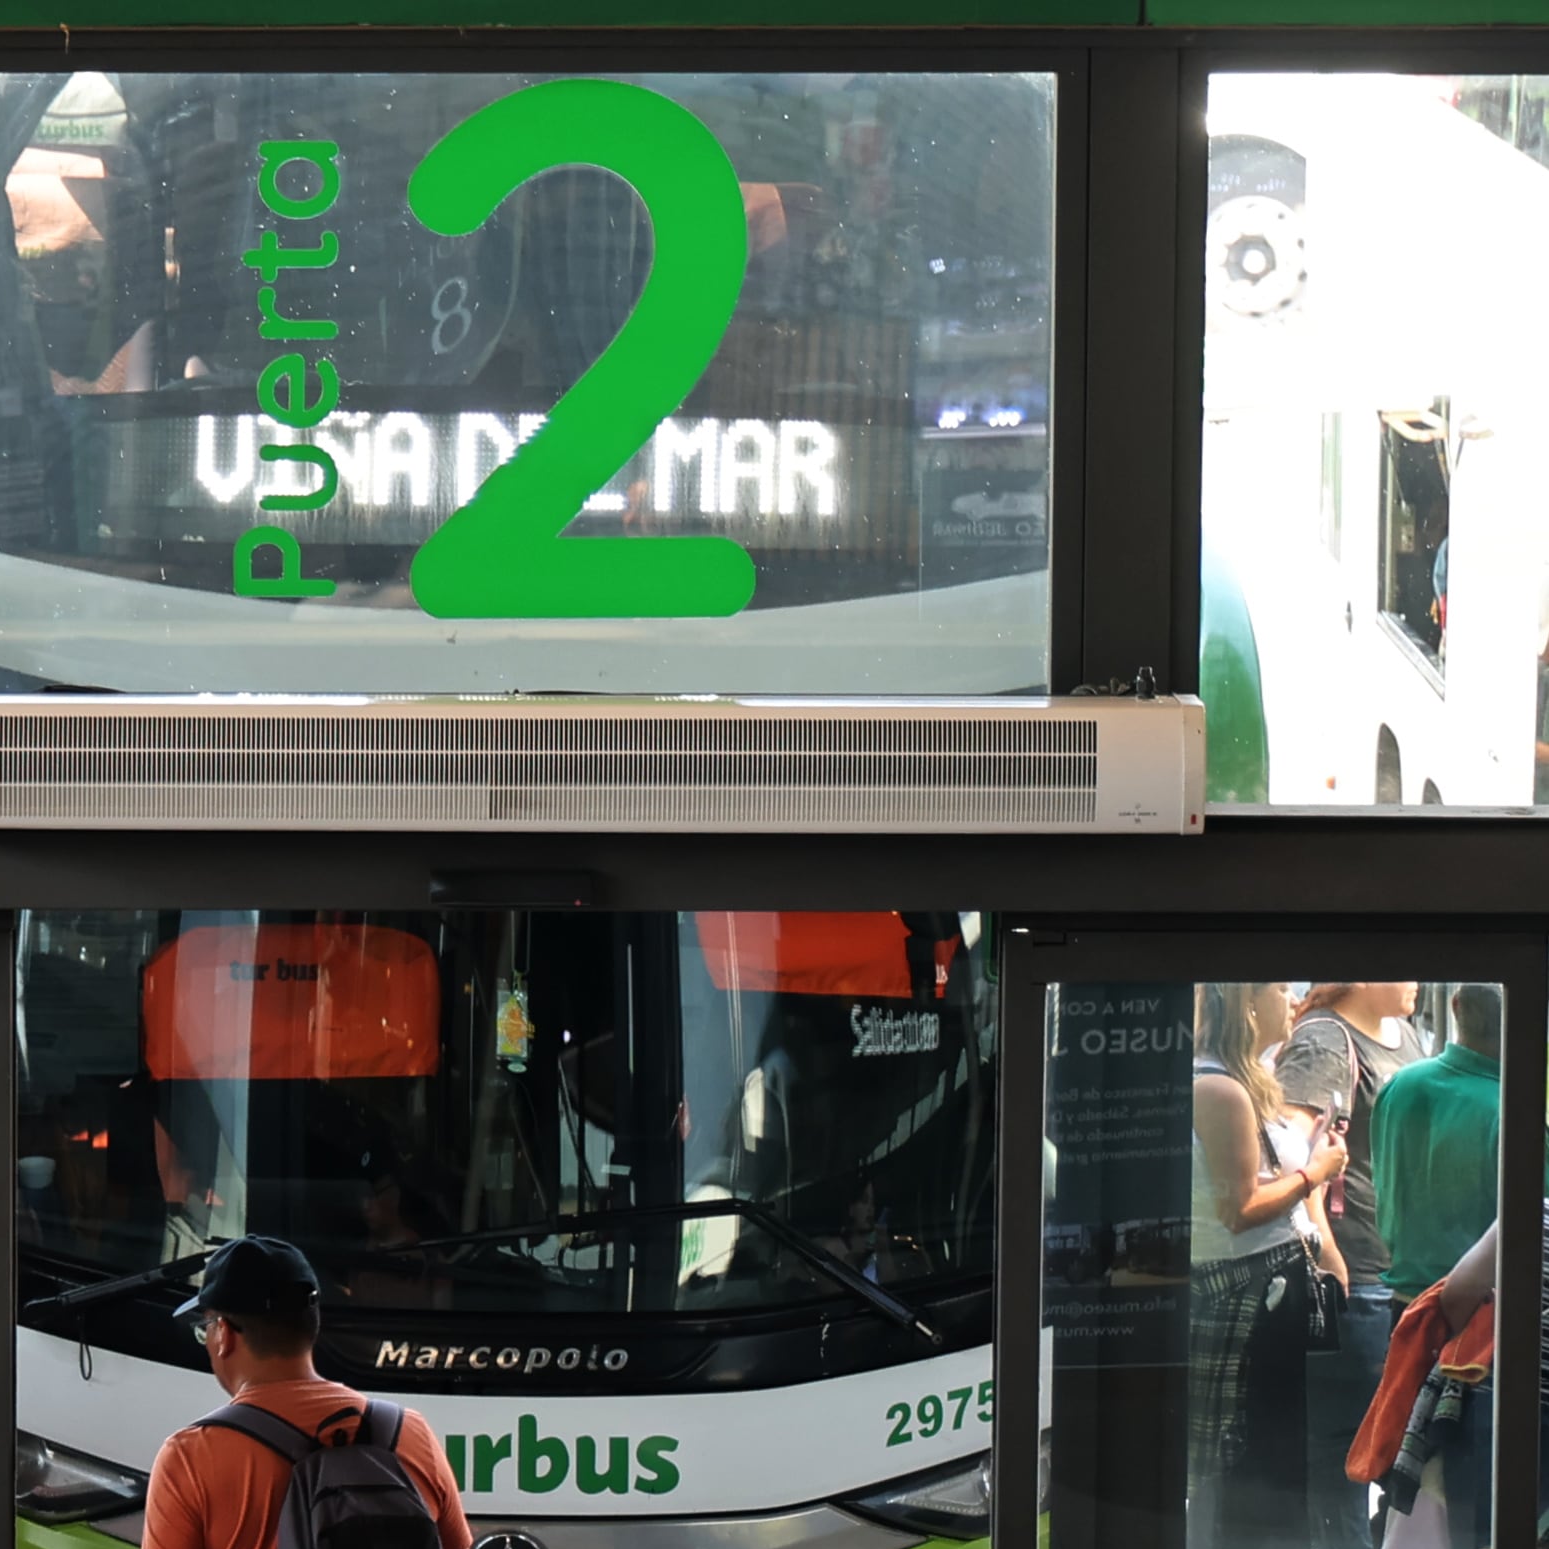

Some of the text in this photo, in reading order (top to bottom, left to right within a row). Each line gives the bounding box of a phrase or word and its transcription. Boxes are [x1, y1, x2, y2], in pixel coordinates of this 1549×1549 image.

[234, 140, 340, 598] Puerta
[407, 78, 757, 619] 2
[653, 417, 838, 515] MAR
[375, 1340, 629, 1374] Marcopolo
[445, 1413, 681, 1495] rbus
[885, 1379, 994, 1448] 2975
